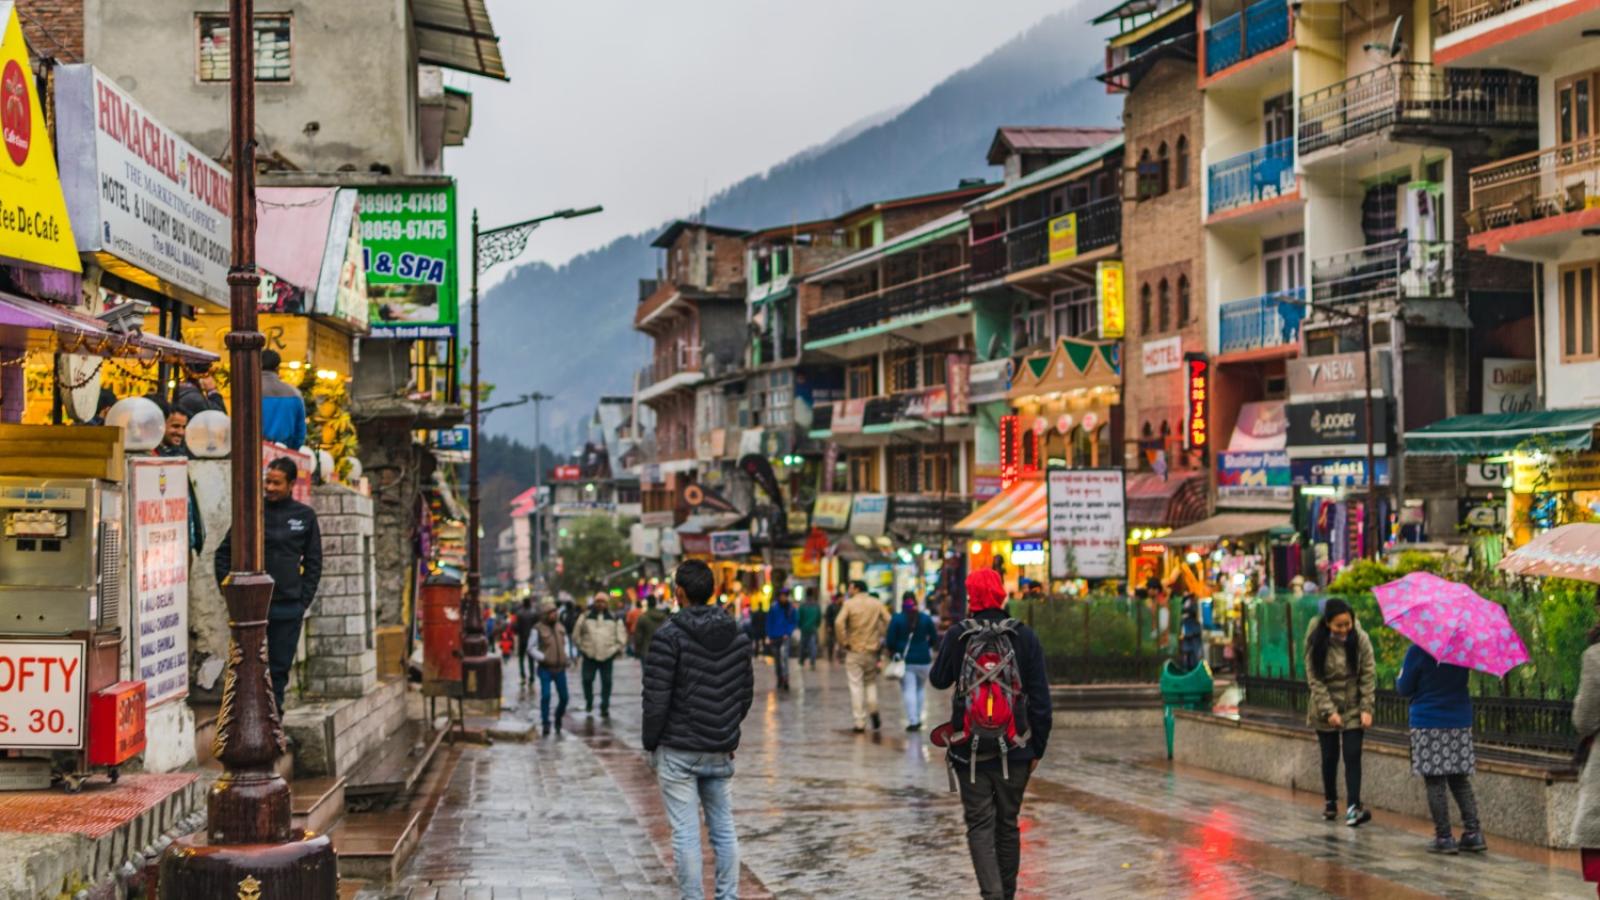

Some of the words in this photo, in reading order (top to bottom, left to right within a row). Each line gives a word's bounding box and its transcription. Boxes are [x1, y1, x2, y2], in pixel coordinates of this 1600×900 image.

[97, 79, 179, 185] HIMACHAL
[124, 160, 142, 188] THE
[144, 174, 191, 219] MARKETING
[18, 206, 32, 236] De
[34, 210, 60, 243] Cafe
[101, 171, 130, 213] HOTEL
[134, 193, 140, 219] &
[142, 198, 170, 237] LUXURY
[172, 217, 186, 246] BUS
[375, 252, 393, 275] &
[397, 251, 446, 284] SPA
[1145, 346, 1178, 366] HOTEL
[28, 709, 73, 733] 30.
